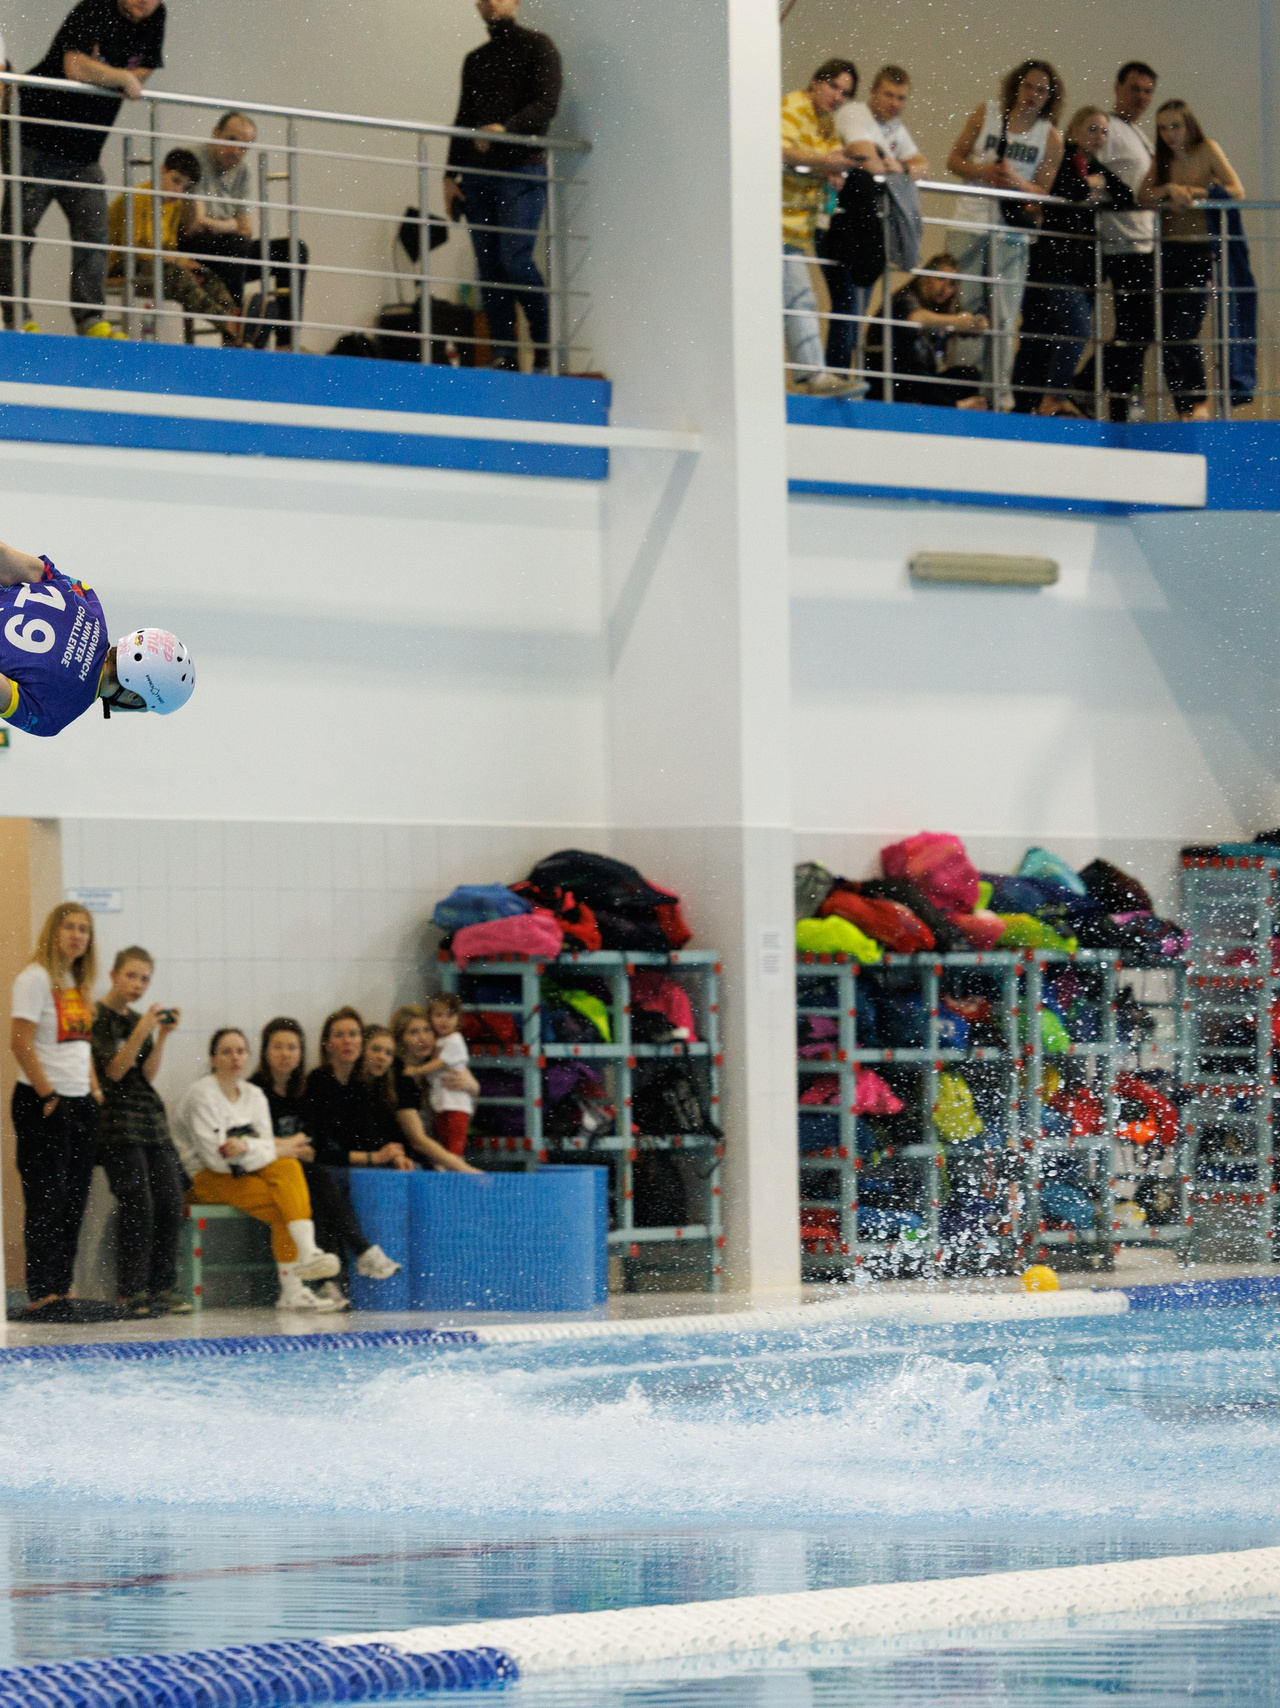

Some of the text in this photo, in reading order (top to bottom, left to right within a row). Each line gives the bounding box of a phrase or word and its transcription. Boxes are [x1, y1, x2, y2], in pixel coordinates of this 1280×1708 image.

[984, 134, 1039, 164] PMA
[4, 582, 66, 654] 19
[61, 605, 86, 668] CHALLENGE
[74, 621, 93, 663] WINTER
